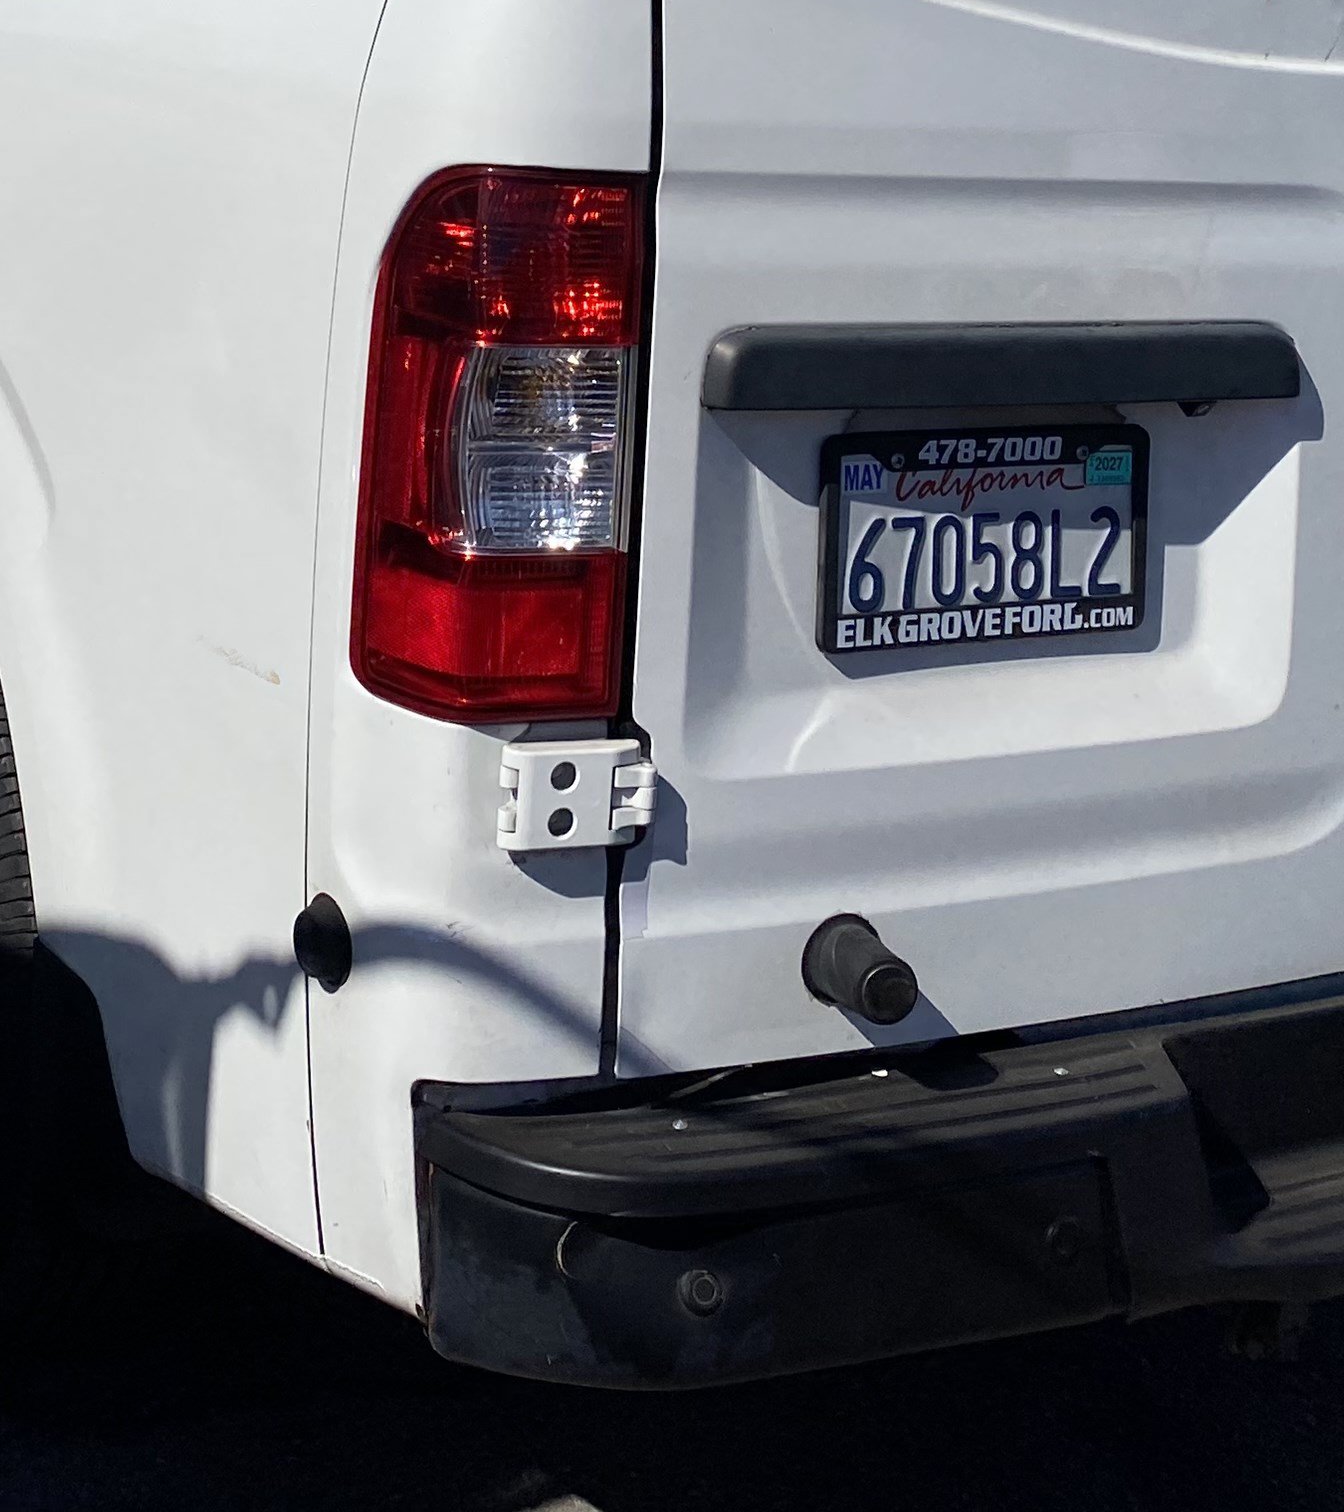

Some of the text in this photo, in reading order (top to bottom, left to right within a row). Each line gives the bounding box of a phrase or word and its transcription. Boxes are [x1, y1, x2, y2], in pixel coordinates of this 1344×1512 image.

[918, 436, 1063, 465] 478-7000
[844, 455, 1124, 512] MAY California 2027
[848, 505, 1122, 613] 67058L2
